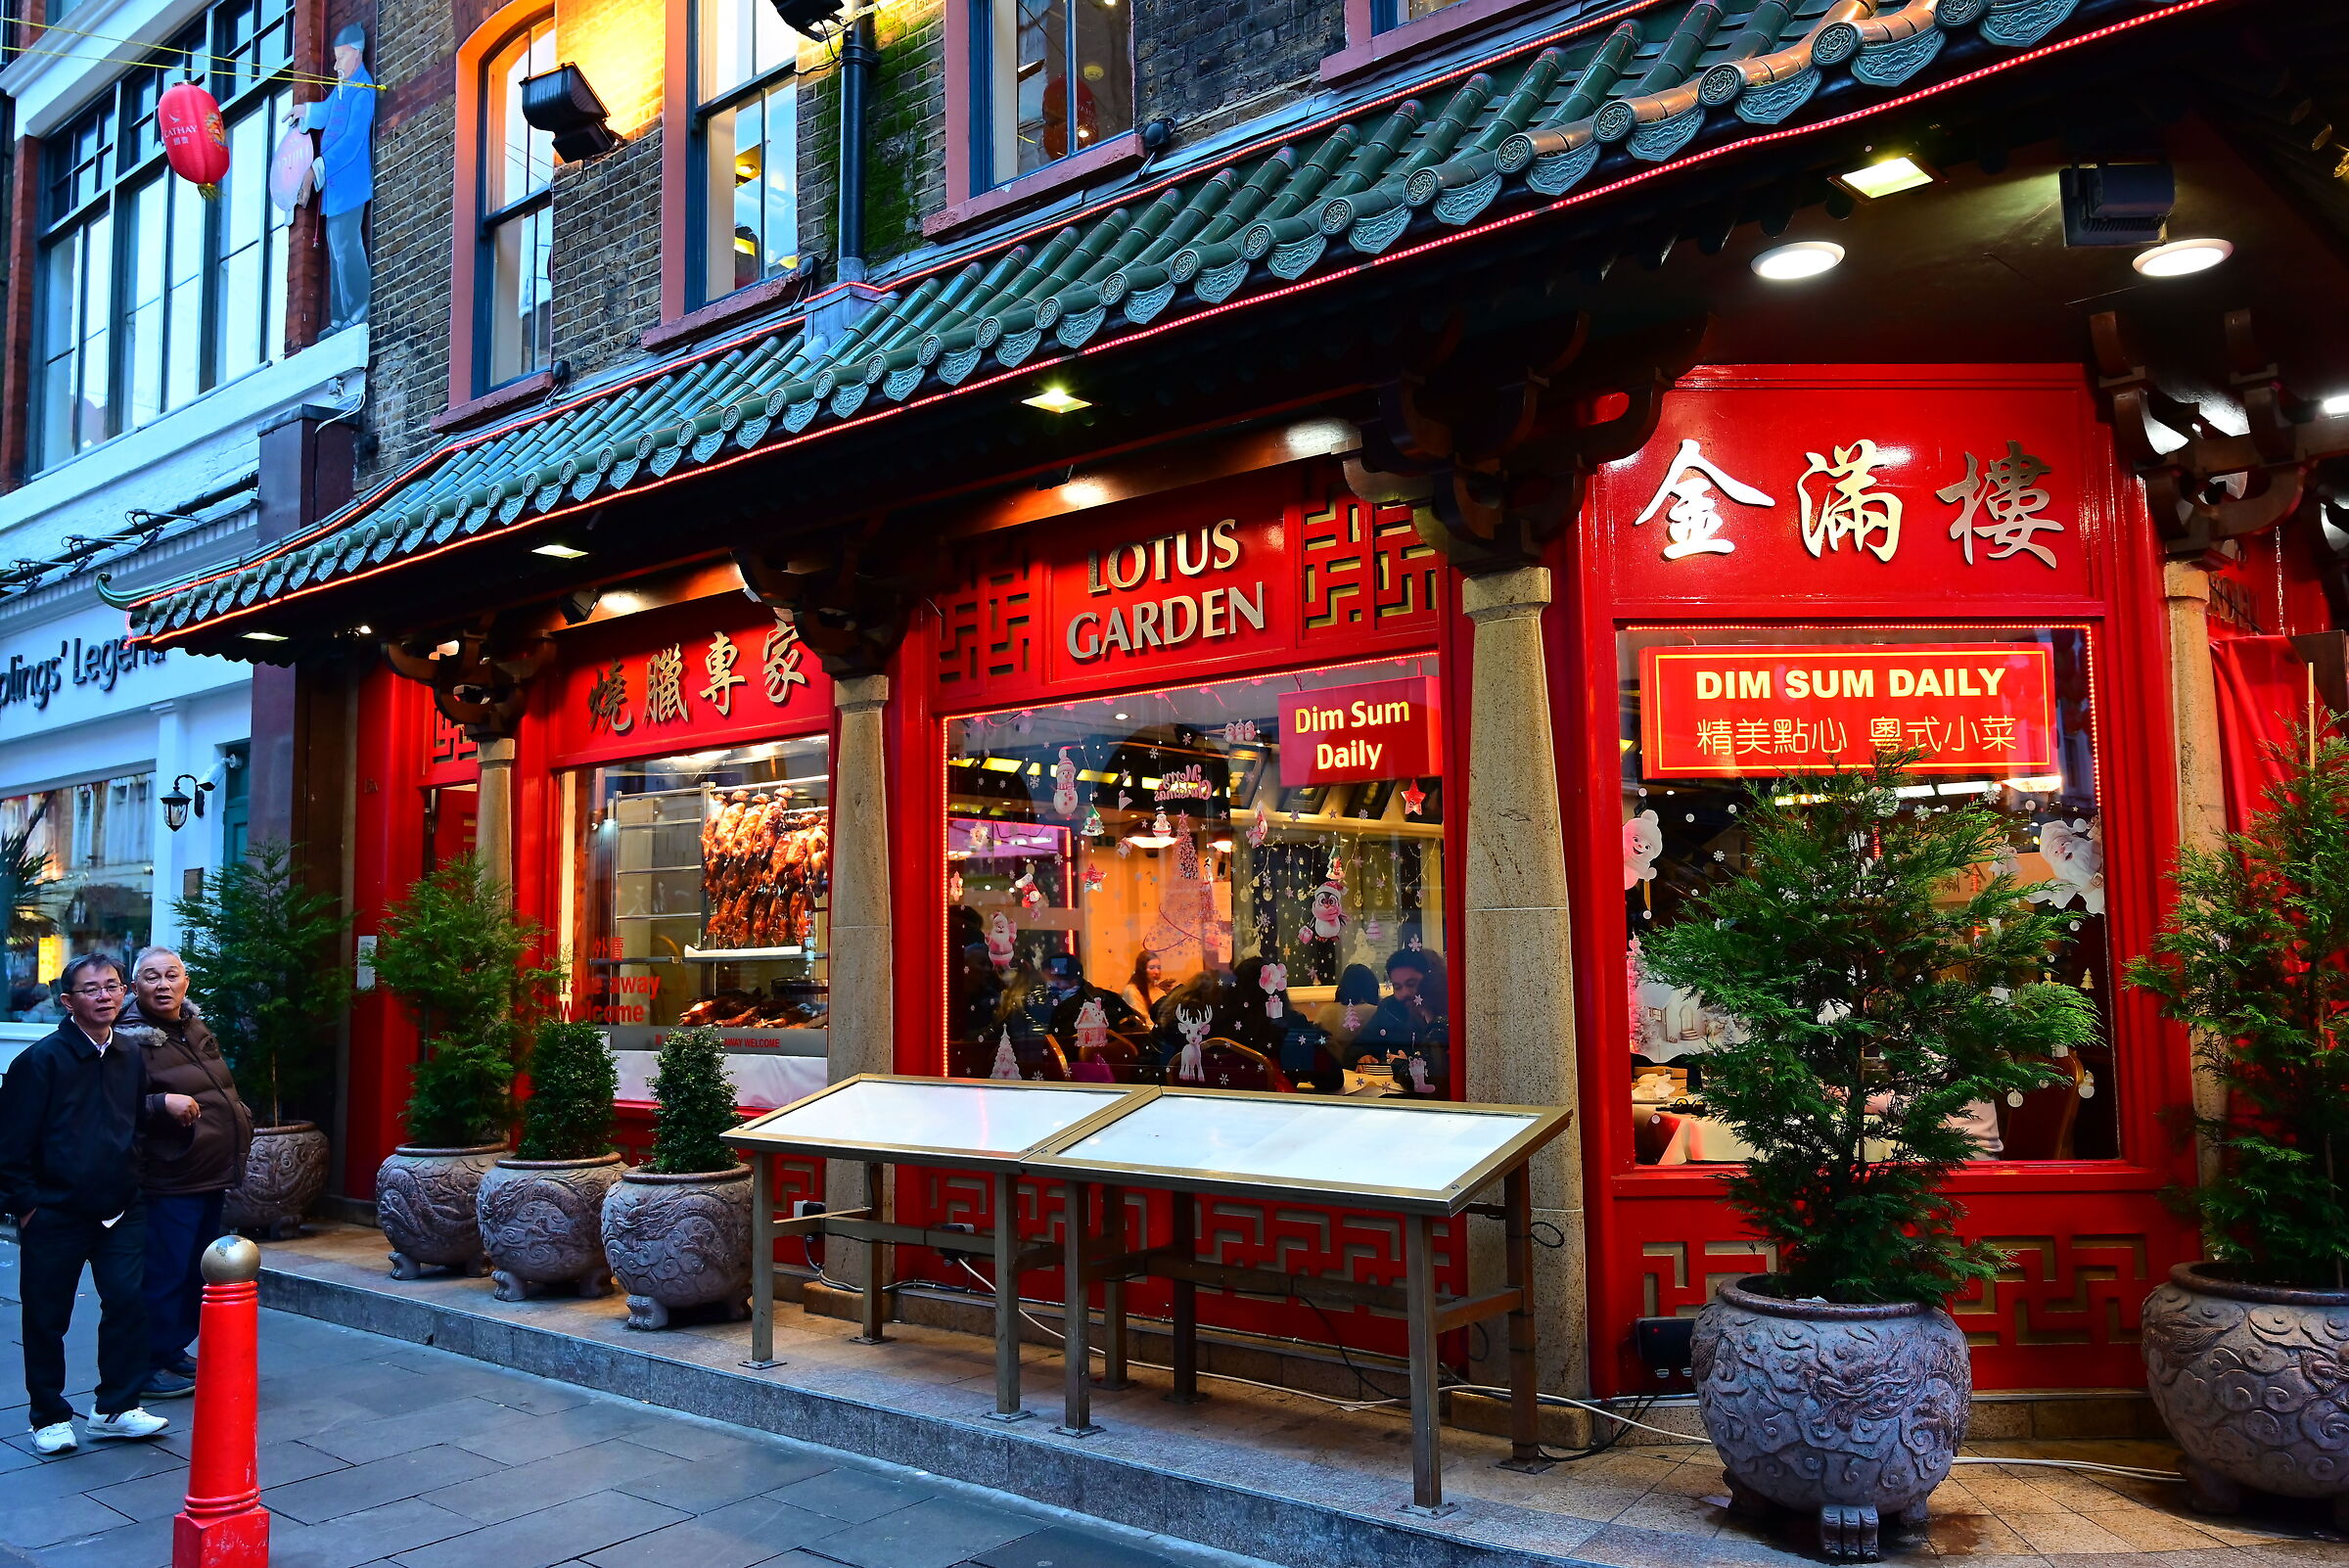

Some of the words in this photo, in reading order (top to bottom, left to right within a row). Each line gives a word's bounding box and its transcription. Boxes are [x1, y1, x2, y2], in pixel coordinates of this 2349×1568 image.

[163, 124, 198, 138] CATHAY
[1634, 439, 2064, 569] 金滿樓
[1087, 518, 1239, 594] LOTUS
[1066, 580, 1265, 660] GARDEN
[1696, 670, 1772, 700] DIM
[1784, 669, 1874, 698] SUM
[1889, 667, 2006, 697] DAILY
[1294, 705, 1345, 734] Dim
[1350, 700, 1410, 728] Sum
[1696, 715, 1848, 757] 精美點心
[1867, 715, 2017, 754] 粵式小菜
[1316, 739, 1383, 770] Daily
[608, 975, 662, 1000] away
[559, 999, 645, 1023] Welcome
[745, 1038, 780, 1048] WELCOME
